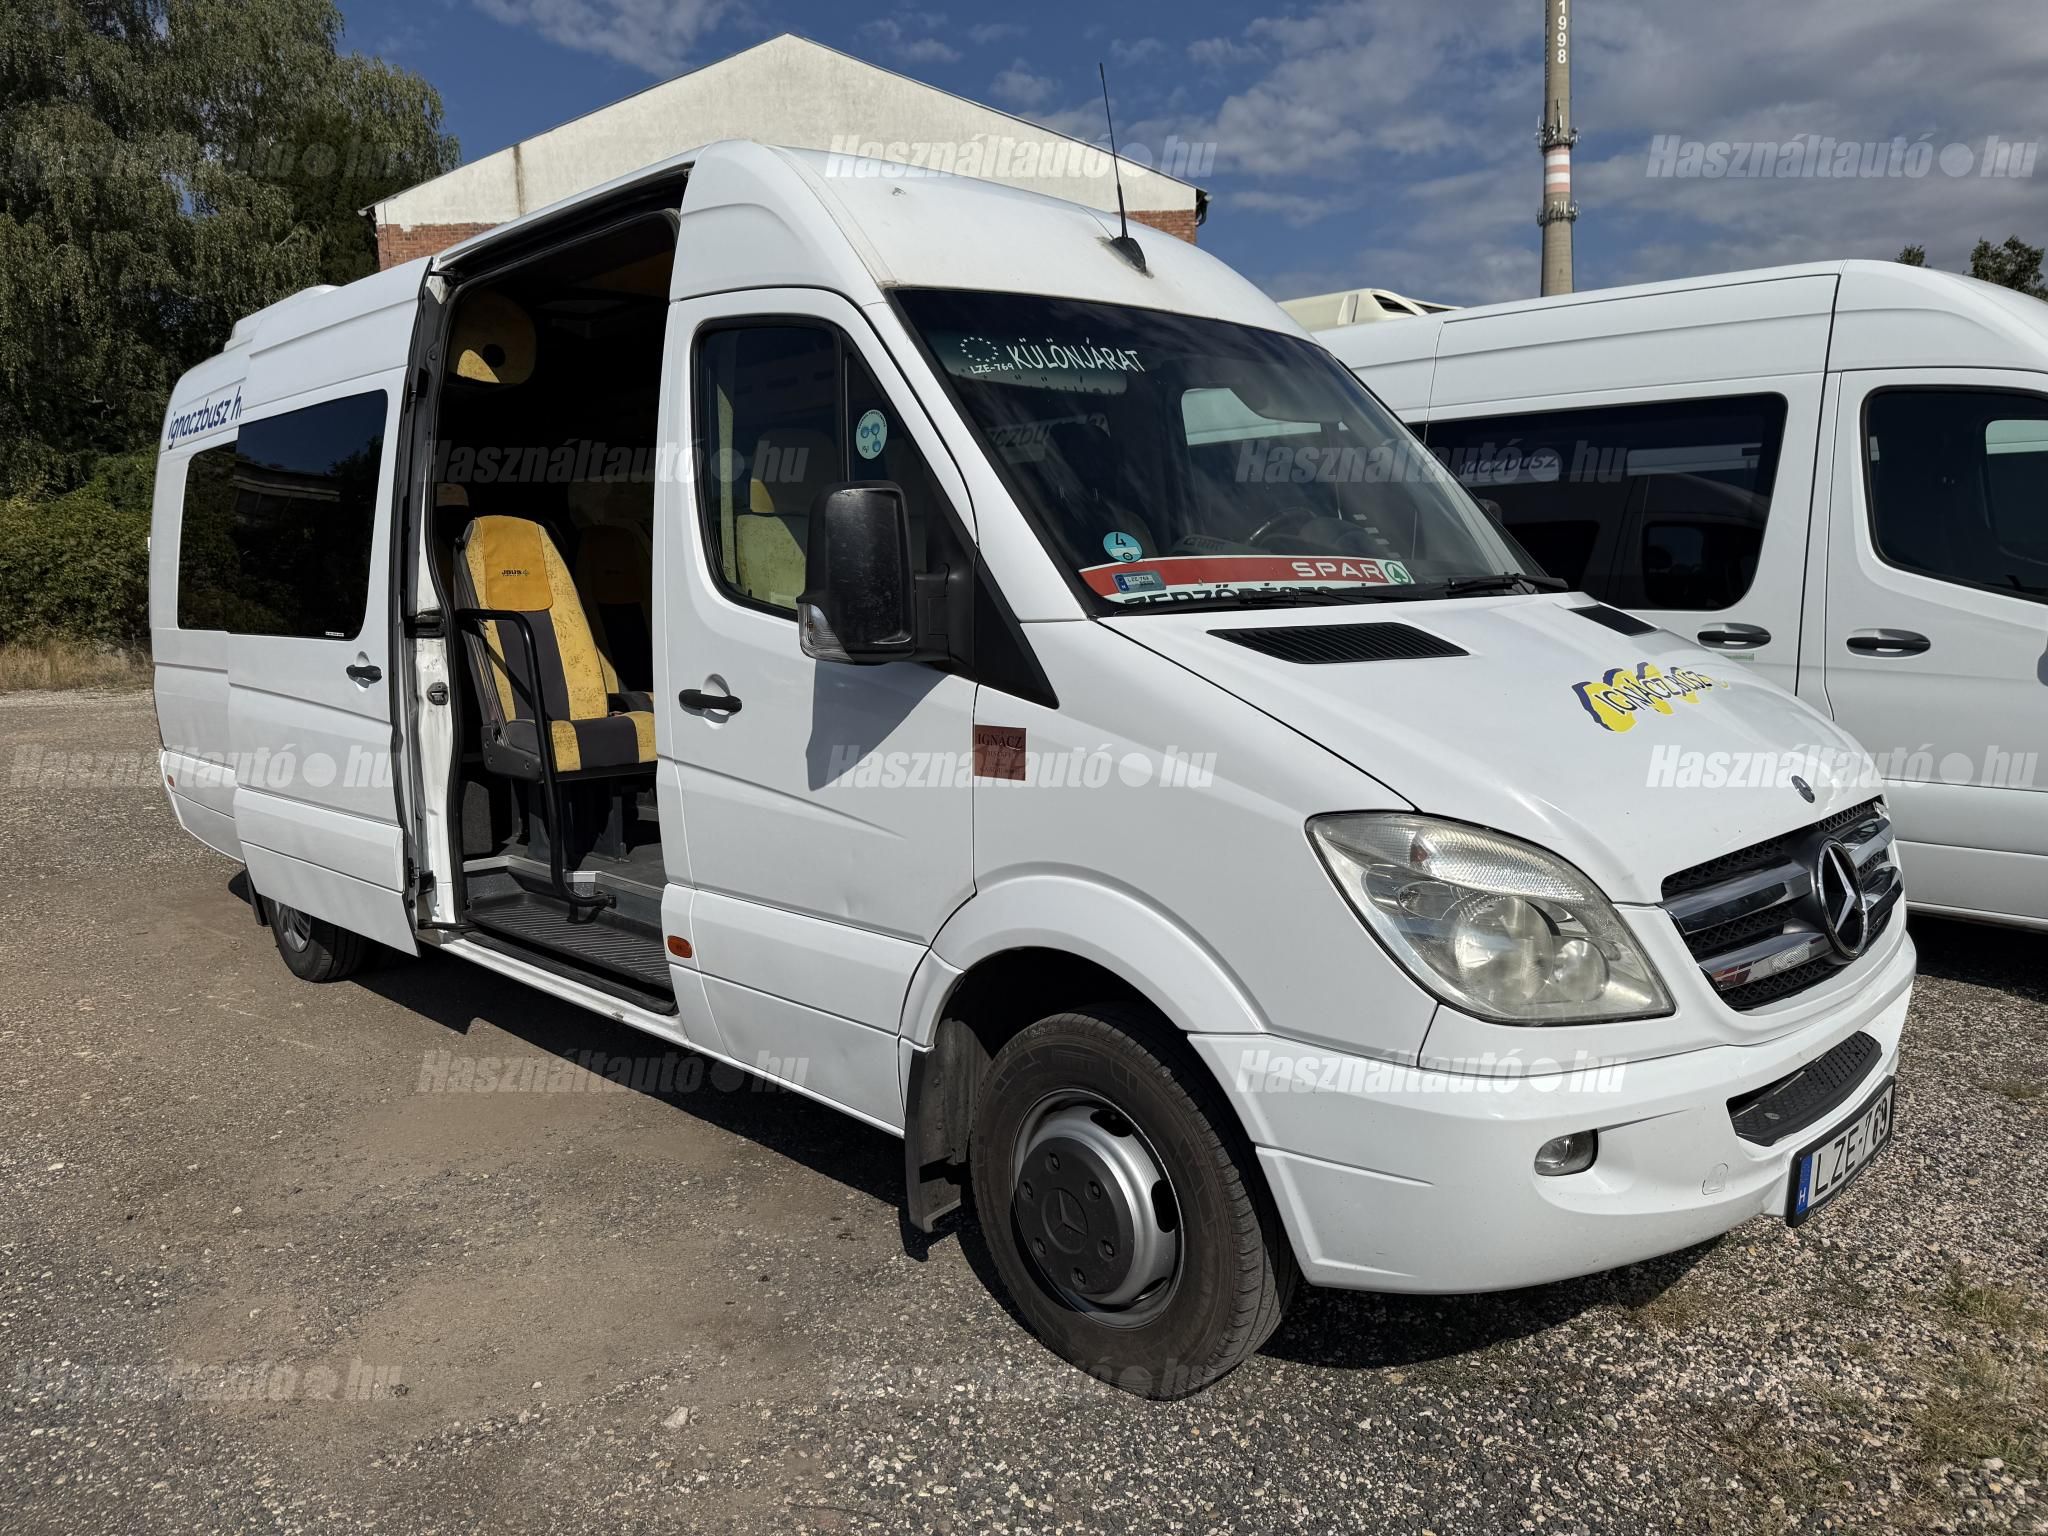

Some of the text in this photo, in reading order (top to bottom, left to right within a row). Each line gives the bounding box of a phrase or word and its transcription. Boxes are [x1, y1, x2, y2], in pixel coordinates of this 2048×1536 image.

[1557, 0, 1567, 64] 1998
[970, 362, 1014, 374] LZE-769
[1007, 338, 1145, 373] KÜLÖNJÁRAT
[168, 397, 231, 450] ignaczbusz
[1115, 533, 1127, 547] 4
[1291, 561, 1384, 580] SPAR
